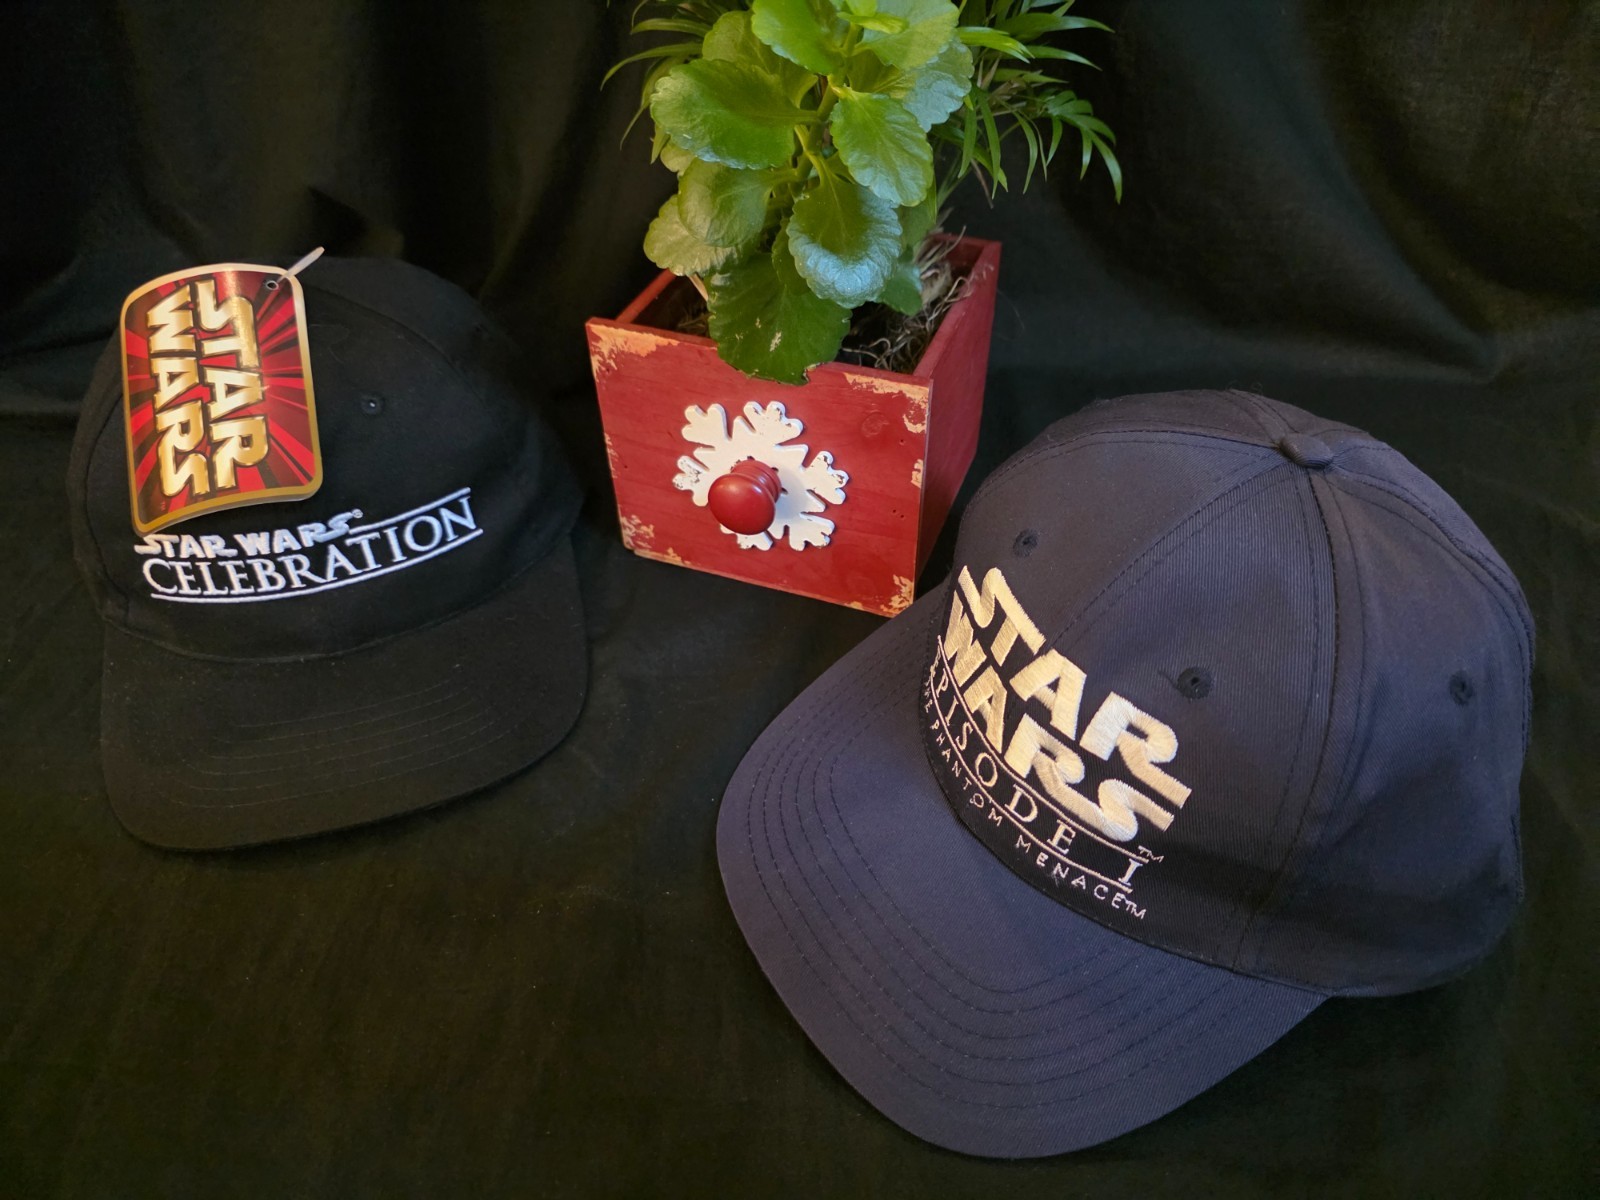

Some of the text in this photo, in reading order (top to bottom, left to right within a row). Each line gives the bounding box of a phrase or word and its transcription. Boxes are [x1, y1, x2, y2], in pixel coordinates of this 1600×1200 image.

[147, 284, 210, 497] WARS
[194, 279, 268, 490] STAR
[134, 512, 354, 560] STAR WARS
[142, 496, 477, 596] CELEBRATION
[929, 718, 1003, 828] PHANTOM
[943, 589, 1175, 843] WARS
[957, 564, 1193, 809] STAR
